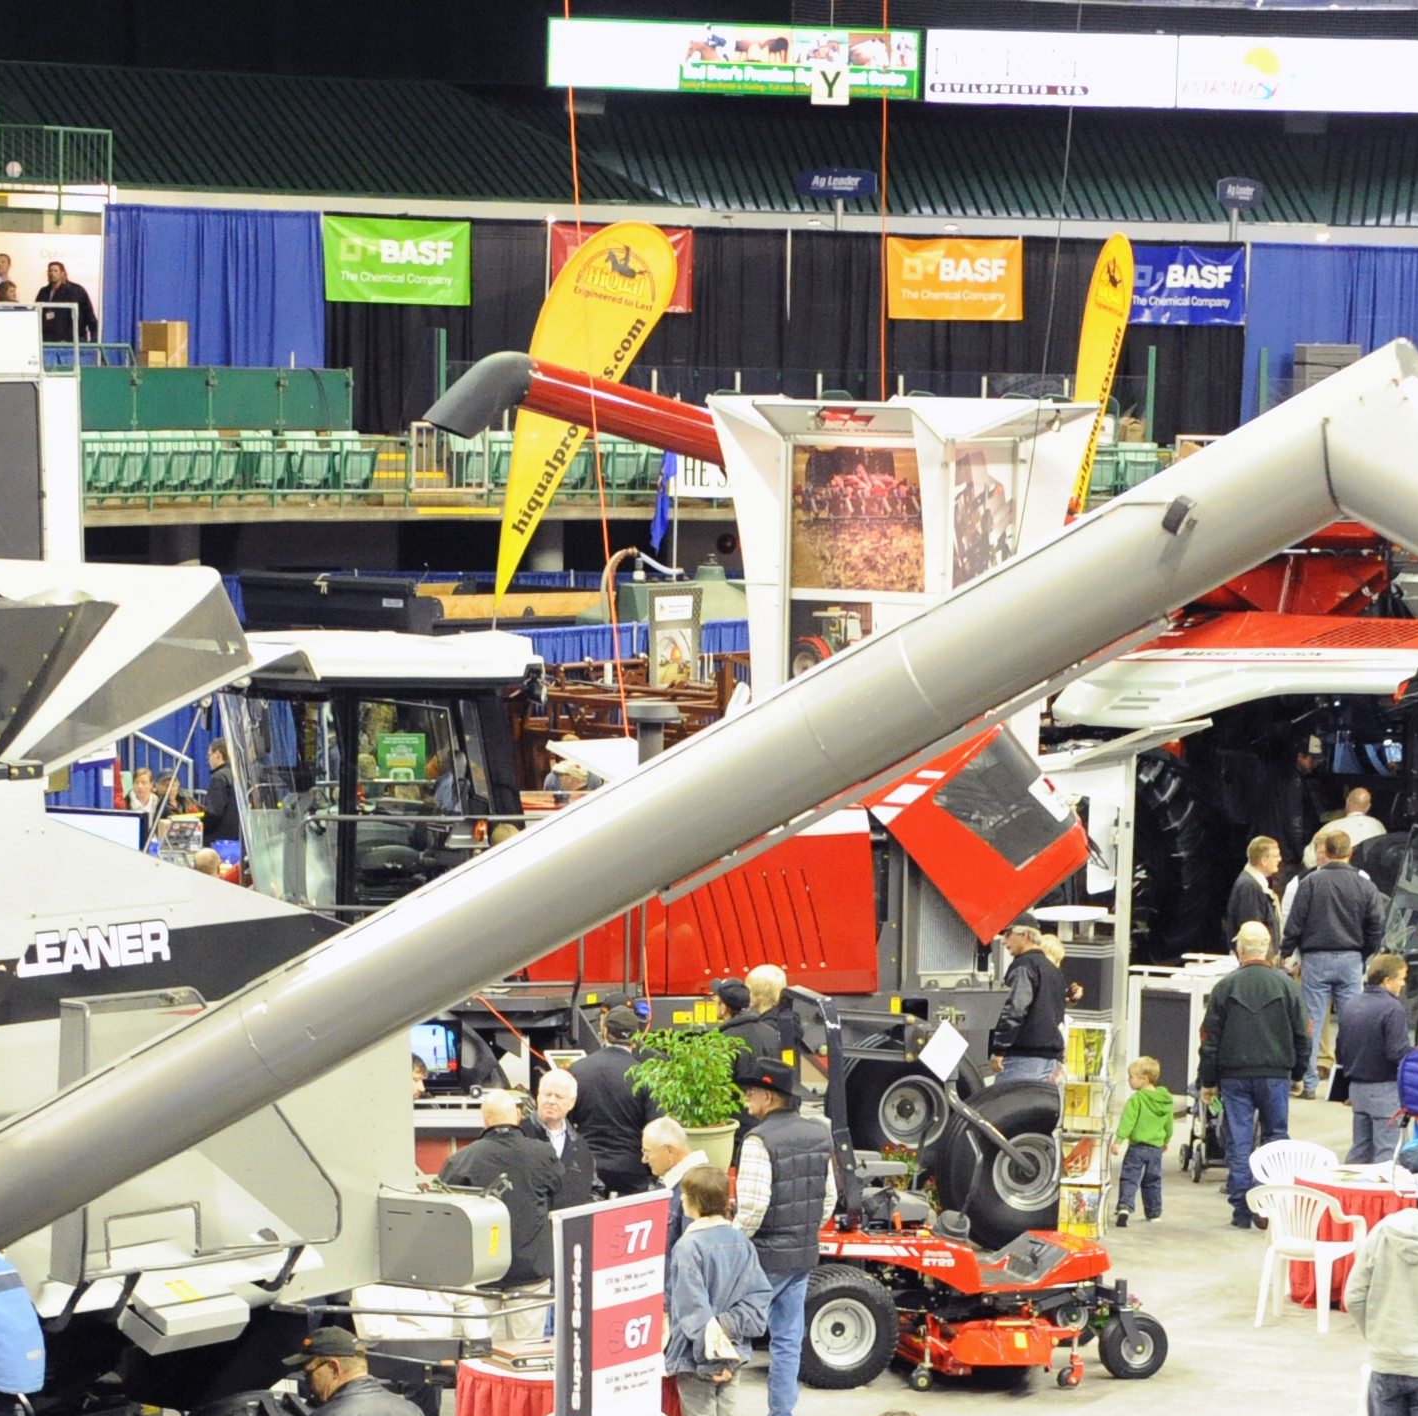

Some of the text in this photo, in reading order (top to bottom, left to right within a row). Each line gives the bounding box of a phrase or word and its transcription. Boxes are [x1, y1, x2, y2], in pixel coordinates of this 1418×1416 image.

[819, 70, 842, 99] Y
[829, 175, 862, 188] Leader
[379, 239, 454, 266] BASF
[341, 270, 453, 287] The Chemical Company
[938, 257, 1007, 282] BASF
[1166, 264, 1233, 289] BASF
[573, 285, 623, 305] Engineered
[634, 300, 653, 313] Last
[901, 288, 1006, 303] The Chemical Company
[1132, 294, 1231, 309] The Chemical Company
